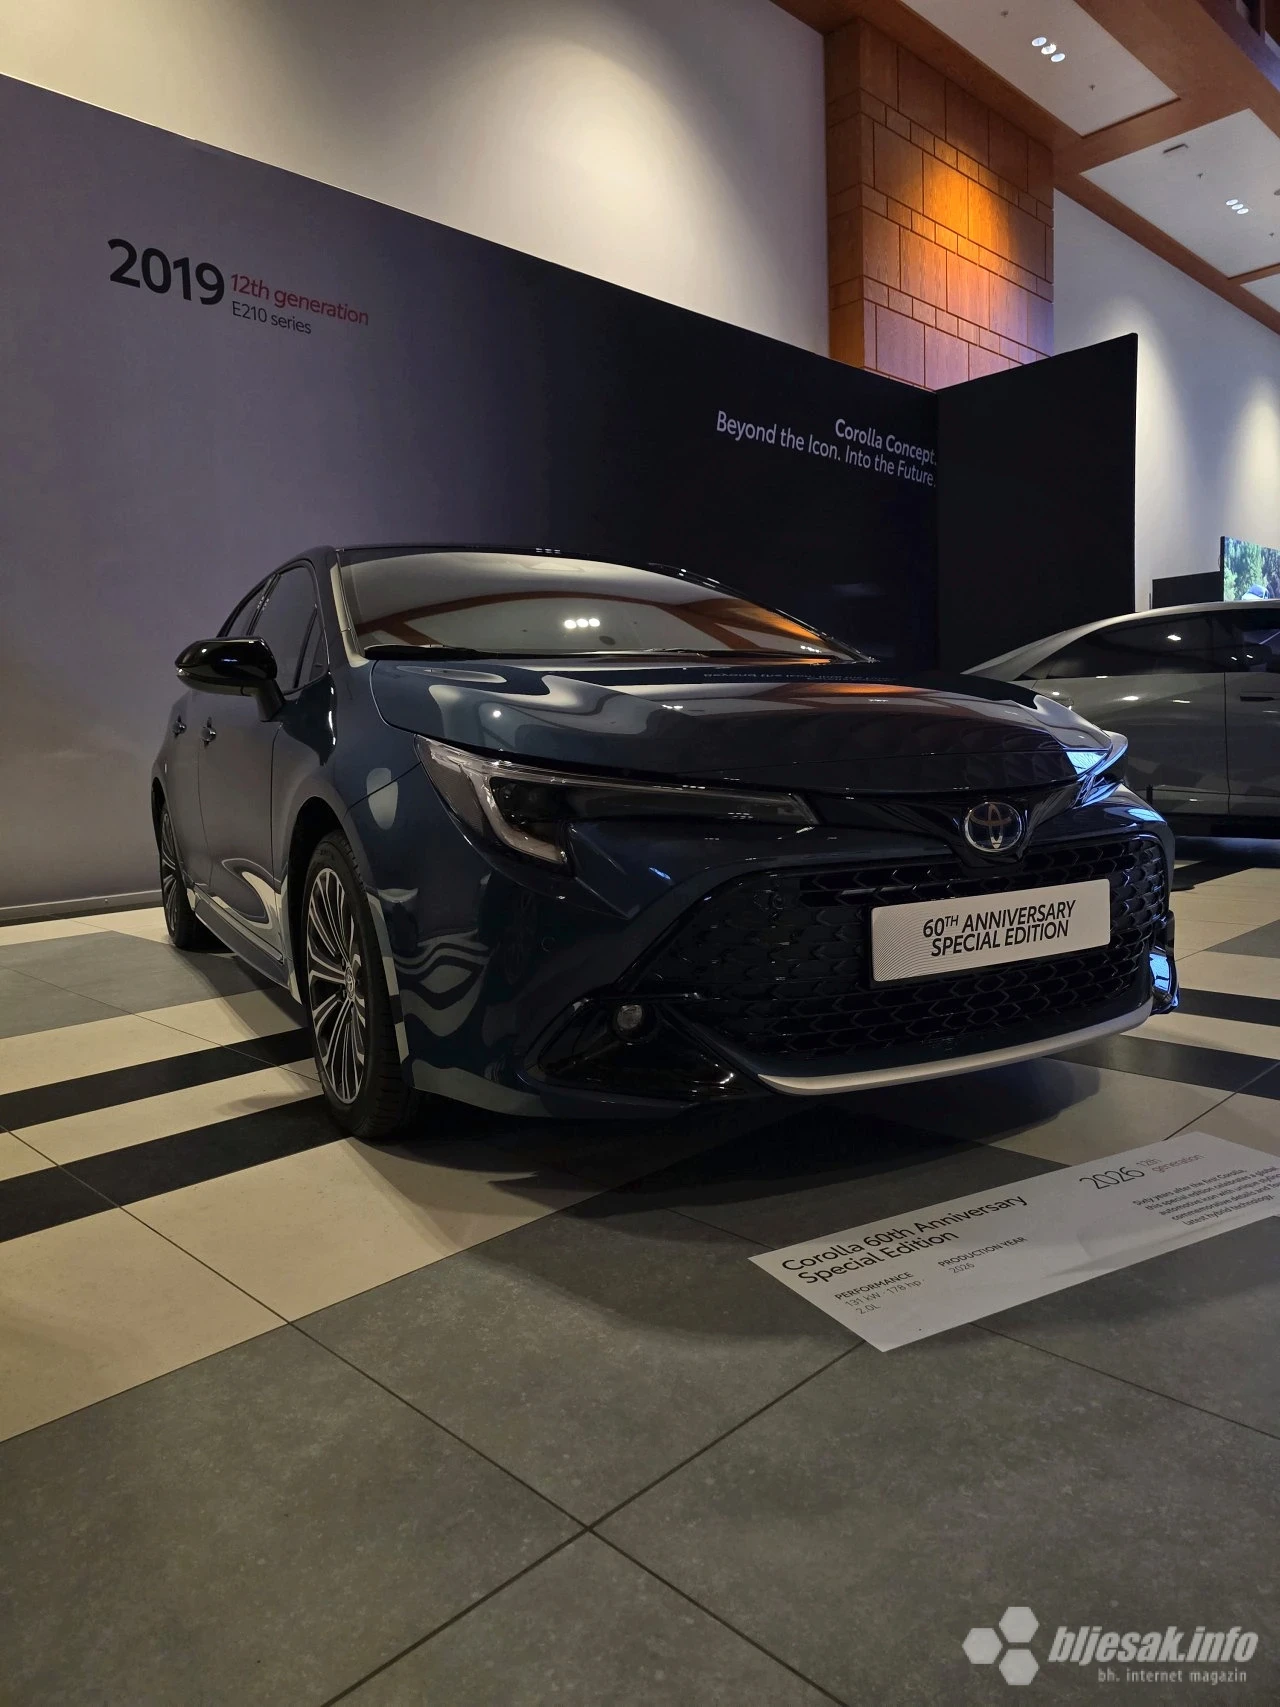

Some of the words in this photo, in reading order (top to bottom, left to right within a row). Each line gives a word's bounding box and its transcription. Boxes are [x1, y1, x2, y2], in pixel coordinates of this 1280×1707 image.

[107, 238, 225, 306] 2019
[230, 273, 270, 301] 12th
[274, 287, 369, 326] generation
[232, 301, 267, 323] E210
[271, 312, 312, 335] series
[716, 410, 777, 445] Beyond
[780, 428, 805, 451] the
[808, 434, 841, 461] Icon.
[845, 445, 871, 469] Into
[874, 454, 895, 475] the
[897, 461, 937, 488] Future.
[835, 418, 882, 450] Corolla
[885, 435, 937, 466] Concept.
[922, 914, 959, 938] 60TH
[961, 899, 1077, 933] ANNIVERSARY
[931, 931, 1000, 957] SPECIAL
[1004, 919, 1069, 947] EDITION
[1079, 1166, 1145, 1190] 2026
[782, 1242, 863, 1272] Corolla
[863, 1226, 916, 1248] 60th
[914, 1195, 1028, 1232] Anniversary
[937, 1244, 1002, 1267] PRODUCTION
[1000, 1236, 1028, 1251] YEAR
[797, 1254, 887, 1285] Special
[881, 1229, 960, 1259] Edition
[948, 1261, 976, 1275] 2026
[834, 1271, 915, 1301] PERFORMANCE
[844, 1296, 864, 1308] 131
[862, 1290, 882, 1304] kW
[886, 1283, 908, 1296] 178
[905, 1279, 923, 1292] hp
[855, 1302, 882, 1316] 2.0L
